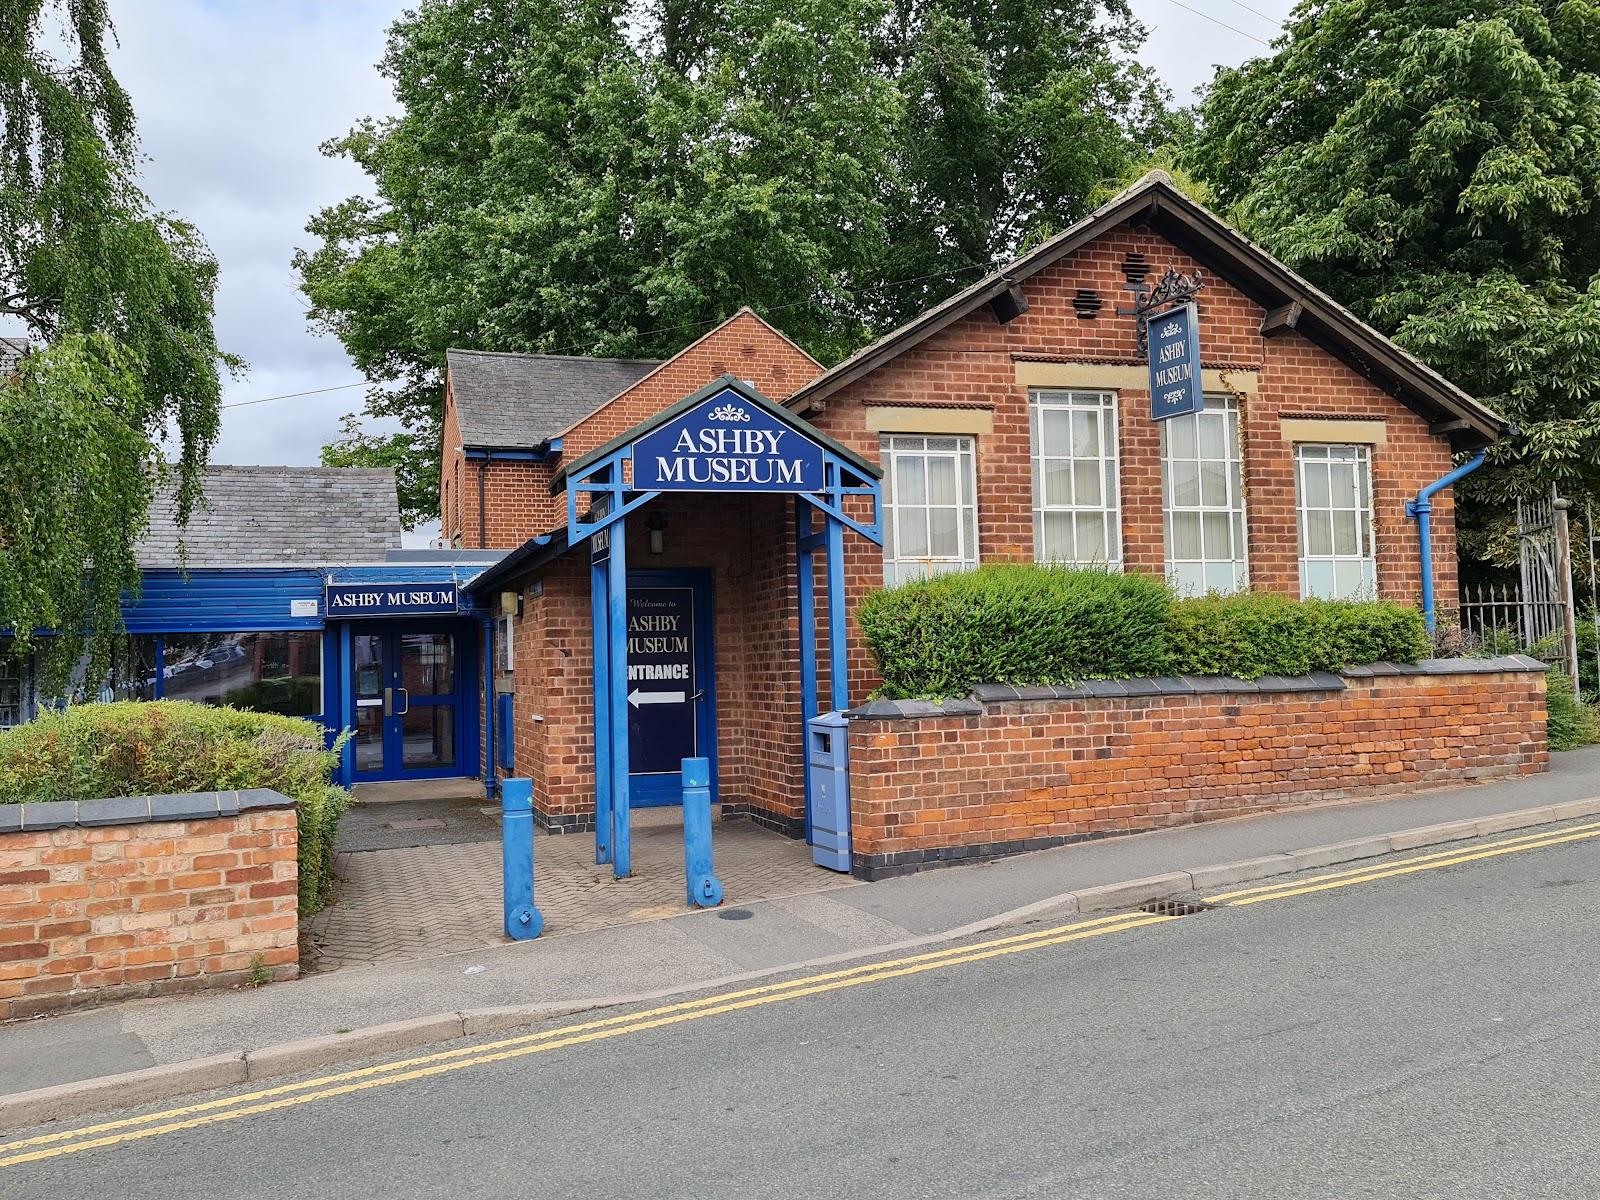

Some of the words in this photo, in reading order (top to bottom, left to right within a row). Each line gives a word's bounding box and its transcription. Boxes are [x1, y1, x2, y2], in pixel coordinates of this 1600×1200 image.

[1158, 340, 1186, 364] ASHBY
[1155, 363, 1192, 388] MUSEUM
[672, 427, 786, 455] ASHBY
[656, 456, 804, 484] MUSEUM
[331, 592, 384, 607] ASHBY
[387, 591, 454, 606] MUSEUM
[630, 599, 667, 608] Welcome
[628, 615, 680, 632] ASHBY
[627, 663, 689, 680] NTRANCE
